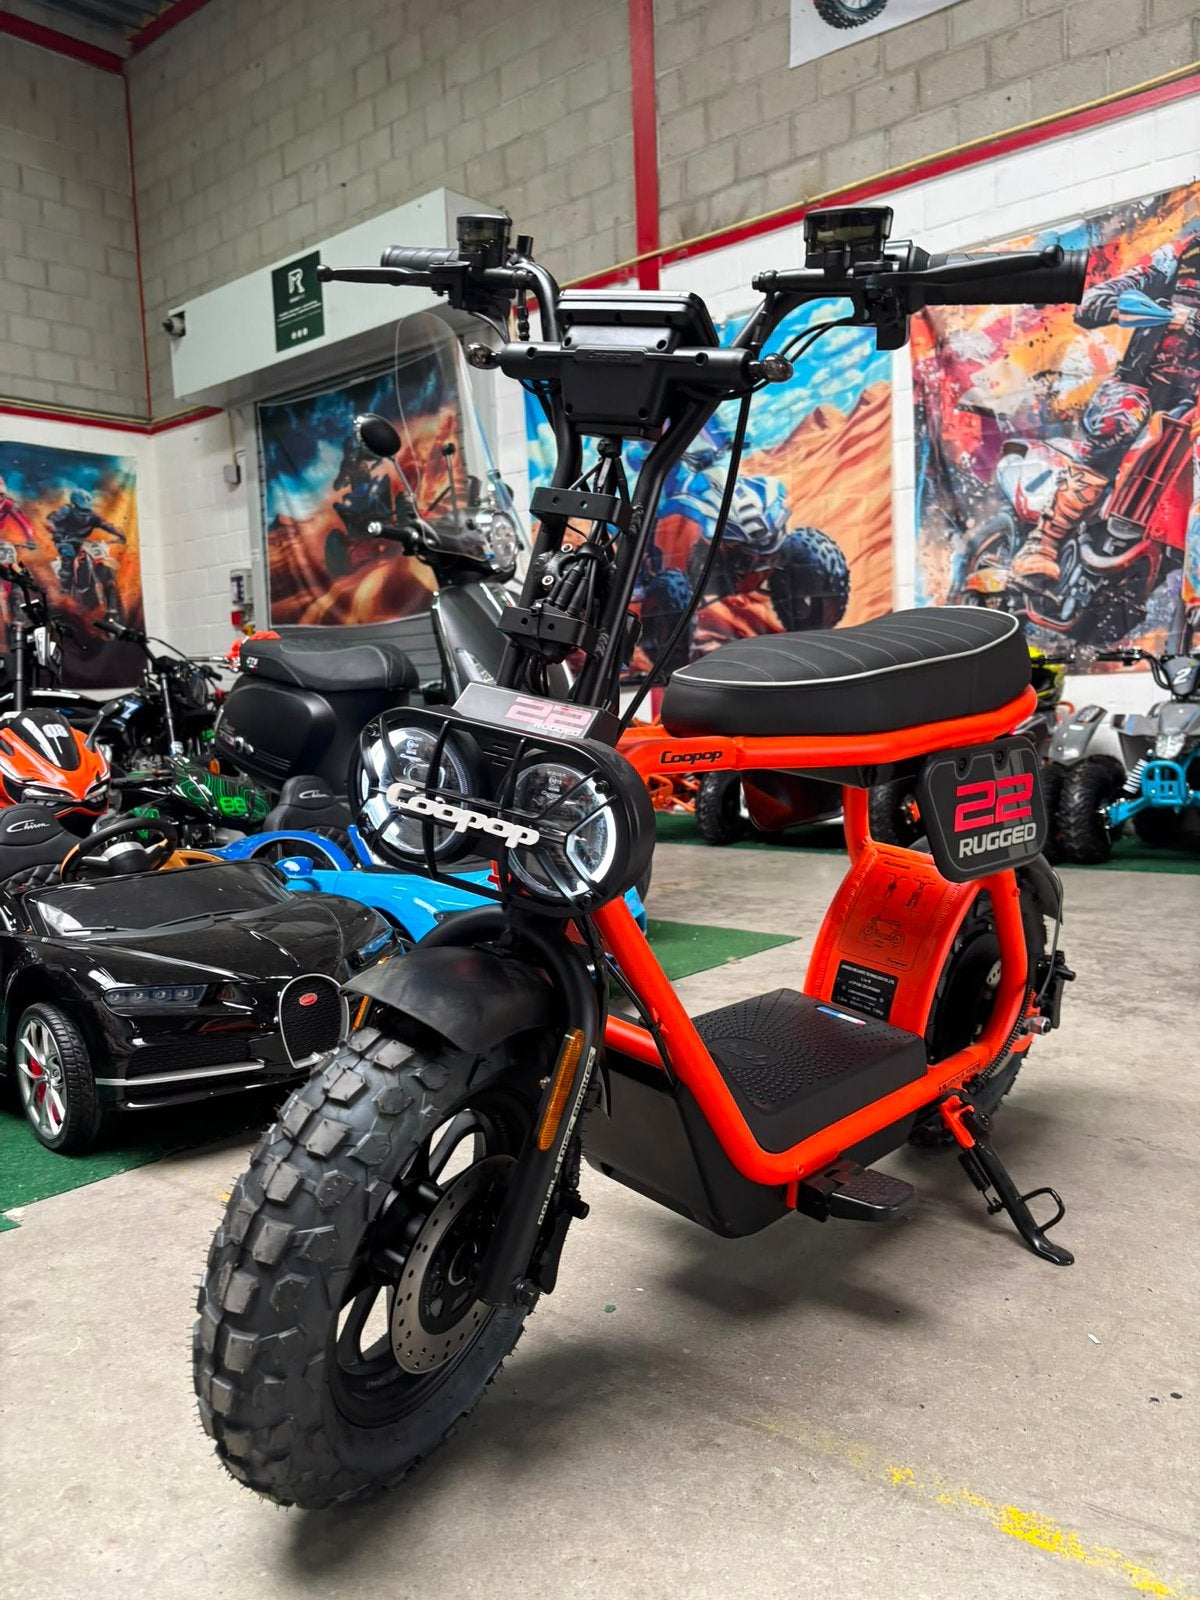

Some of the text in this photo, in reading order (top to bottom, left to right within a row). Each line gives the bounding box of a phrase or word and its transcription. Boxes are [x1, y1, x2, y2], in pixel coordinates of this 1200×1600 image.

[1173, 667, 1192, 684] 2
[505, 697, 592, 728] 22
[660, 750, 722, 765] Coopop
[385, 782, 540, 849] Coopop
[954, 773, 1034, 832] 22
[6, 819, 51, 833] Chiron
[959, 822, 1037, 858] RUGGED
[537, 1050, 597, 1226] DOUBLE DISC BRAKES
